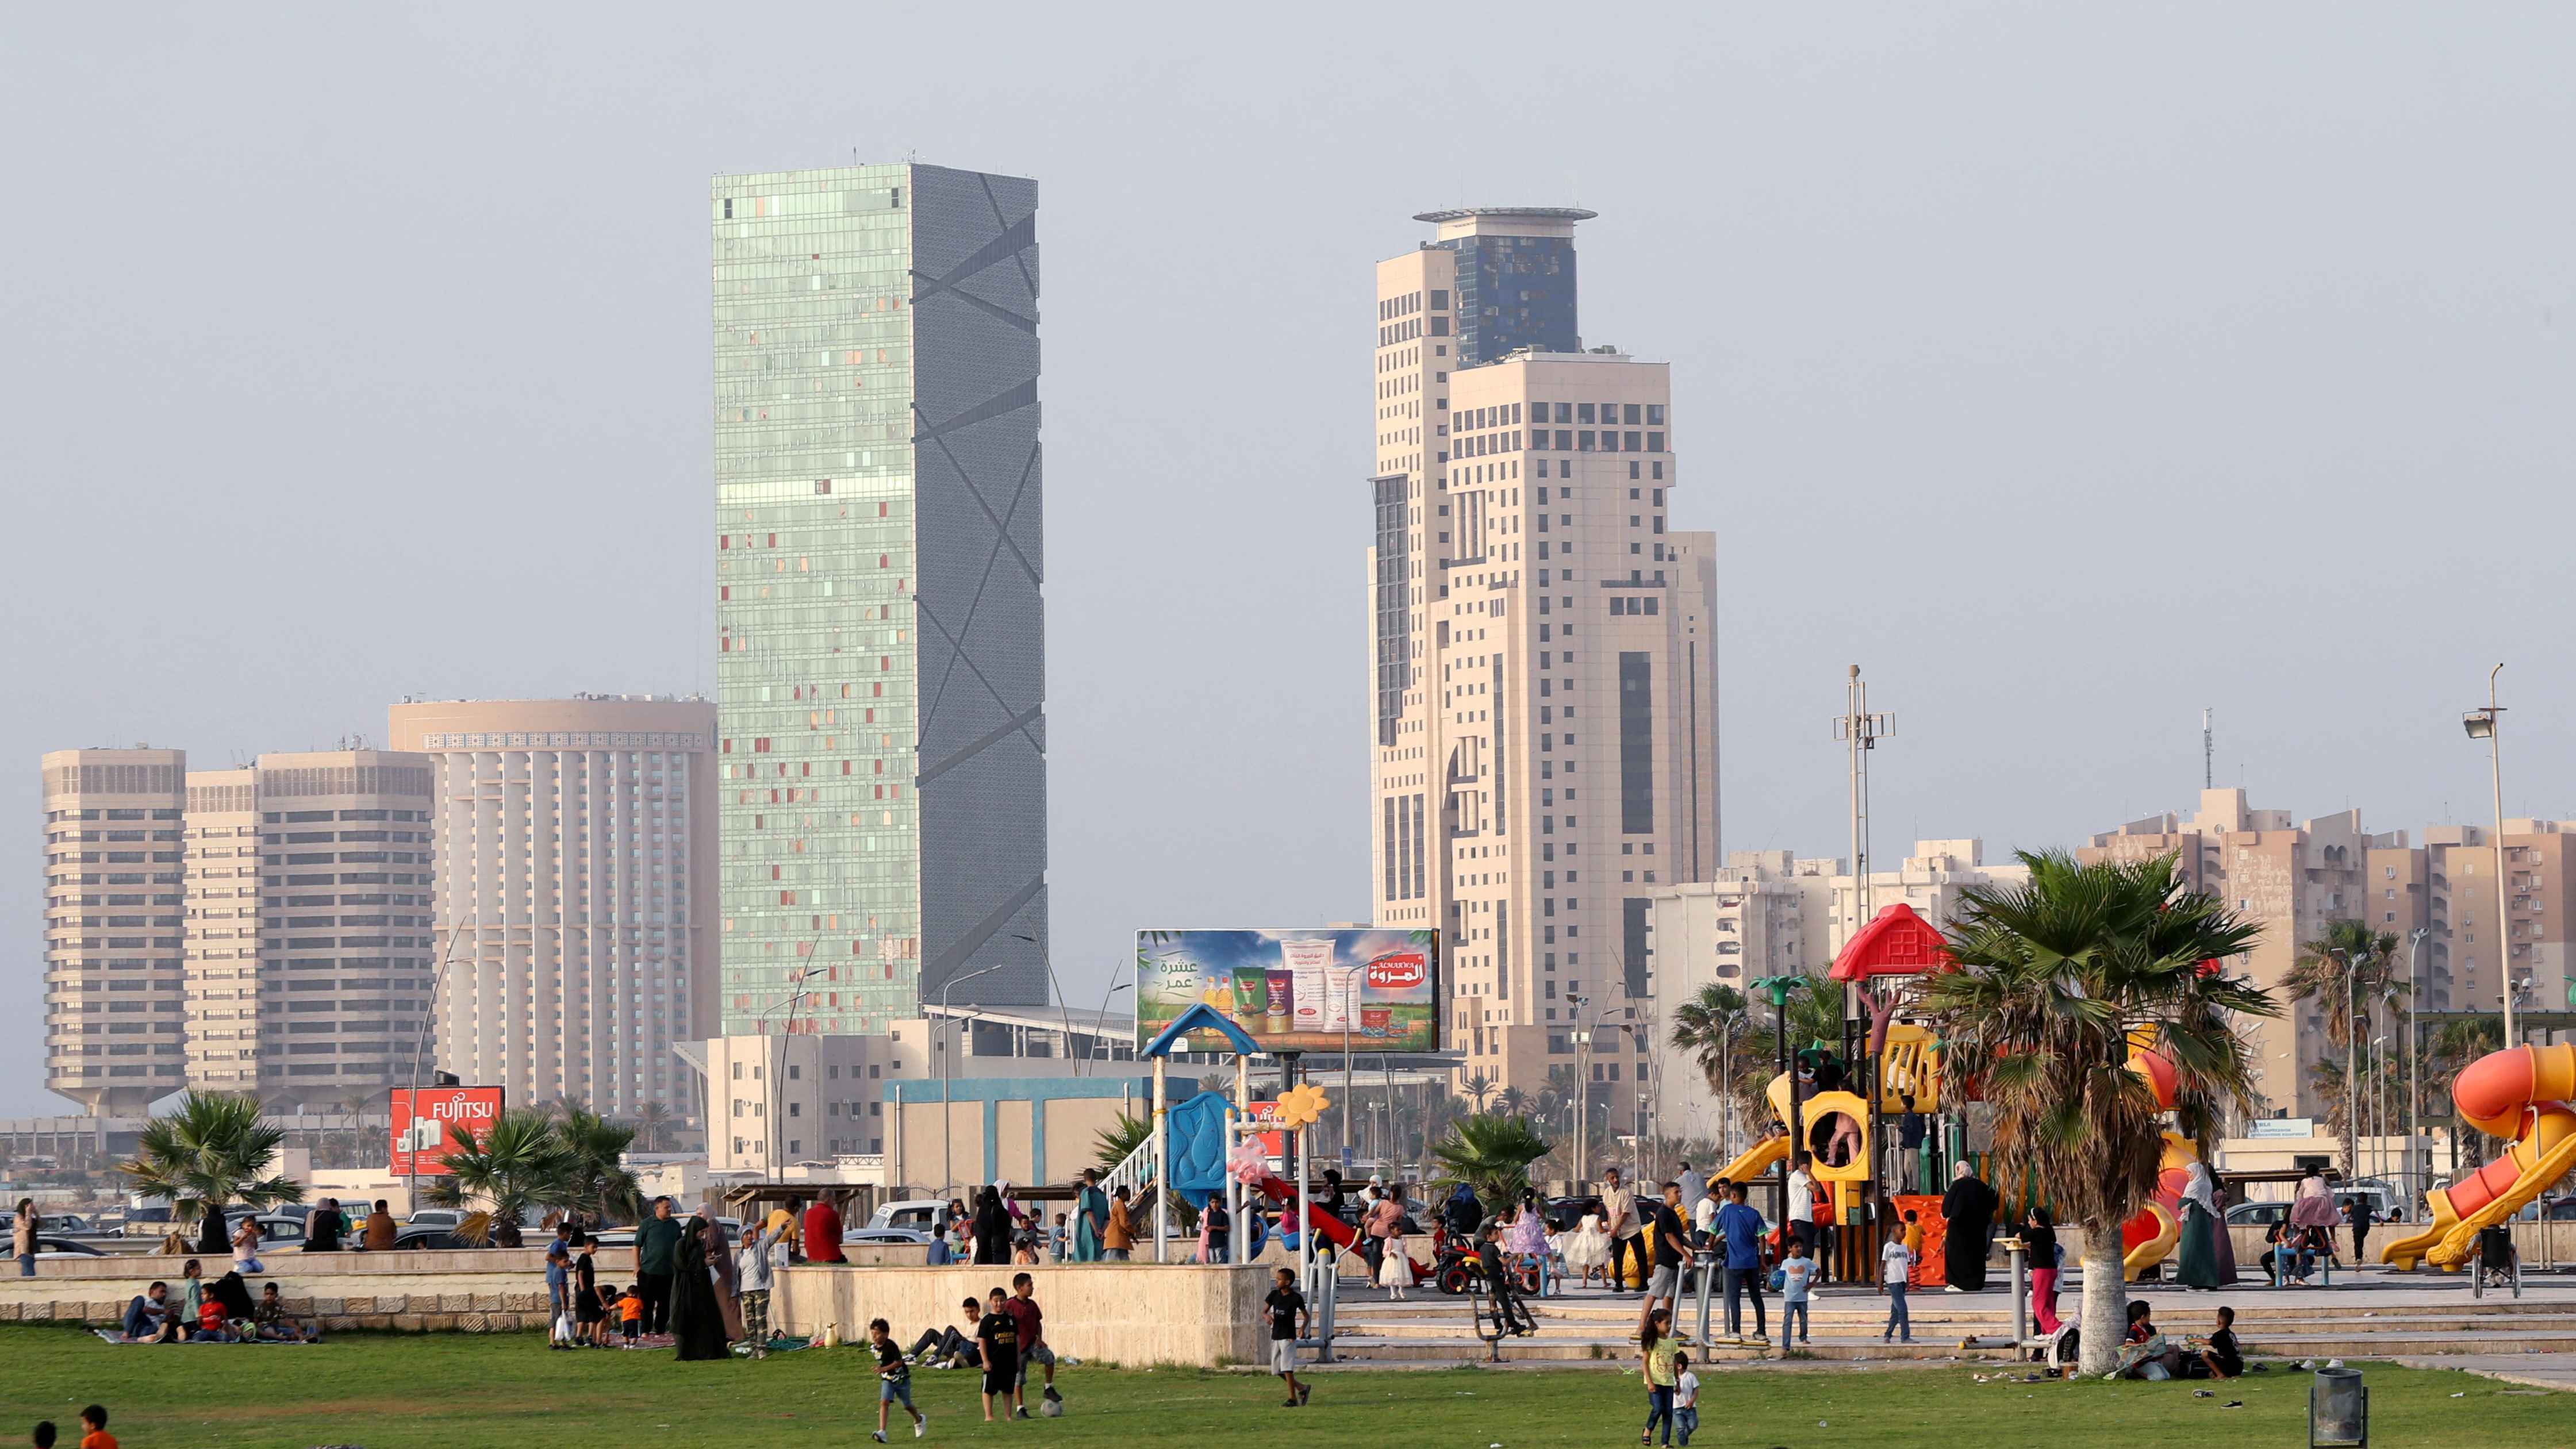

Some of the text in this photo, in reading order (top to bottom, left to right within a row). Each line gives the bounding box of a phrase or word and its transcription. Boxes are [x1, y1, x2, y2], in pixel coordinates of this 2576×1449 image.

[1160, 959, 1198, 975] عشرة
[1369, 964, 1423, 983] المروة
[1165, 978, 1193, 990] عمر
[433, 1092, 493, 1123] FUJITSU
